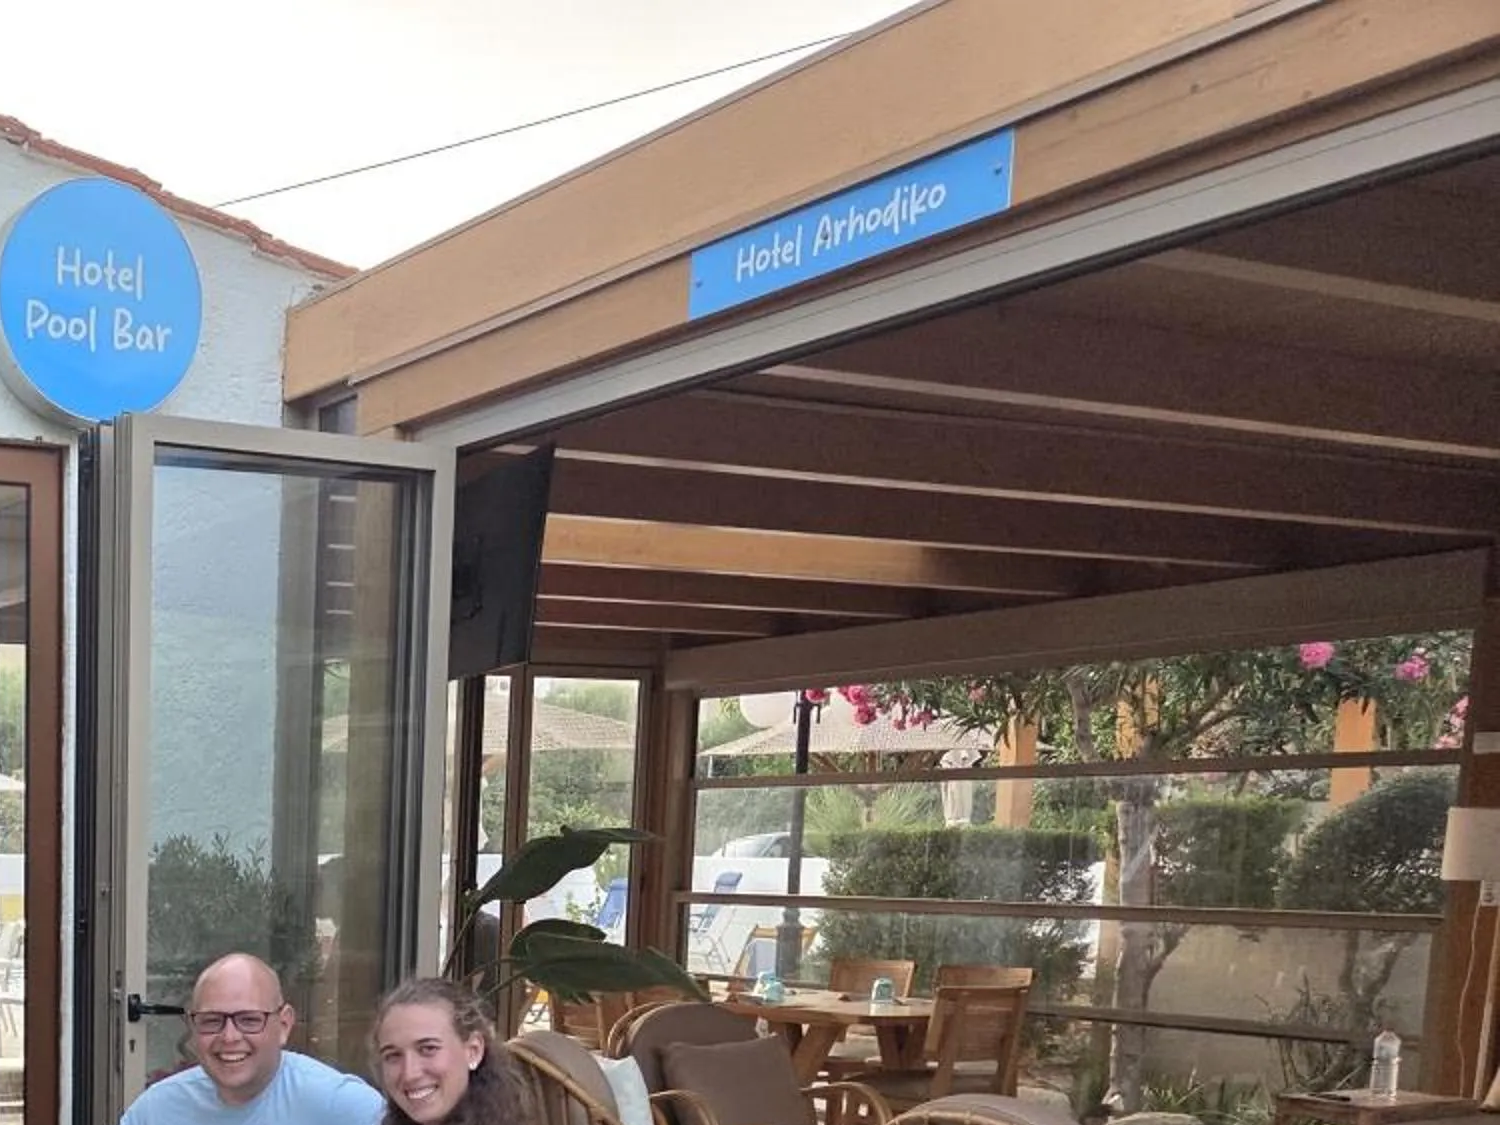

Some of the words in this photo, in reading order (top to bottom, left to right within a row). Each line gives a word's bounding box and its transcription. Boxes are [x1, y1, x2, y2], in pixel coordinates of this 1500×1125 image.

[735, 223, 803, 282] Hotel
[813, 182, 947, 256] Arhodiko
[56, 245, 144, 301] Hotel
[26, 299, 97, 352] Pool
[113, 307, 172, 352] Bar
